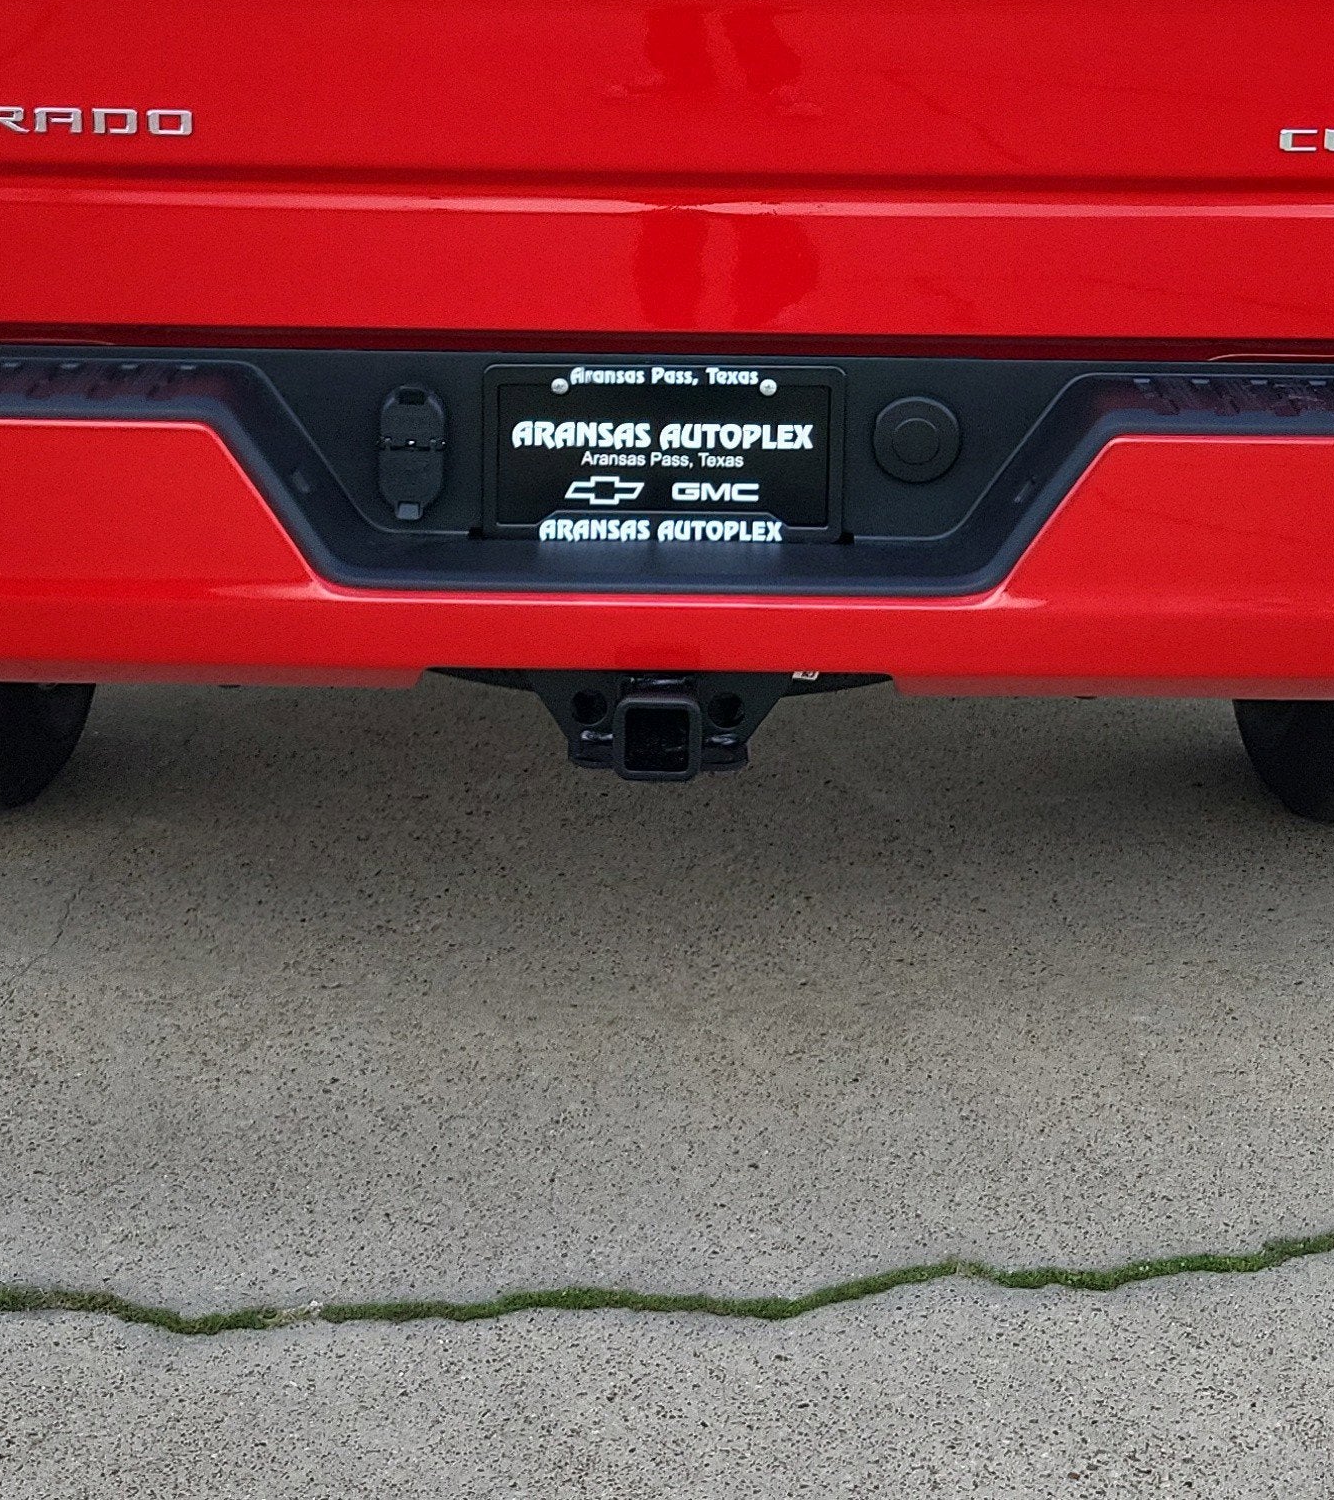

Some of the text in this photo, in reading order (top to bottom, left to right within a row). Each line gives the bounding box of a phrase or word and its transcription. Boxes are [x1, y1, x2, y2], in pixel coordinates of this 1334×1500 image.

[570, 367, 759, 386] Aransas Pass, Texas
[512, 420, 814, 450] ARANSAS AUTOPLEX
[581, 451, 744, 469] Aransas Pass, Texas
[671, 482, 759, 502] GMC
[539, 518, 783, 542] ARANSAS AUTOPLEX
